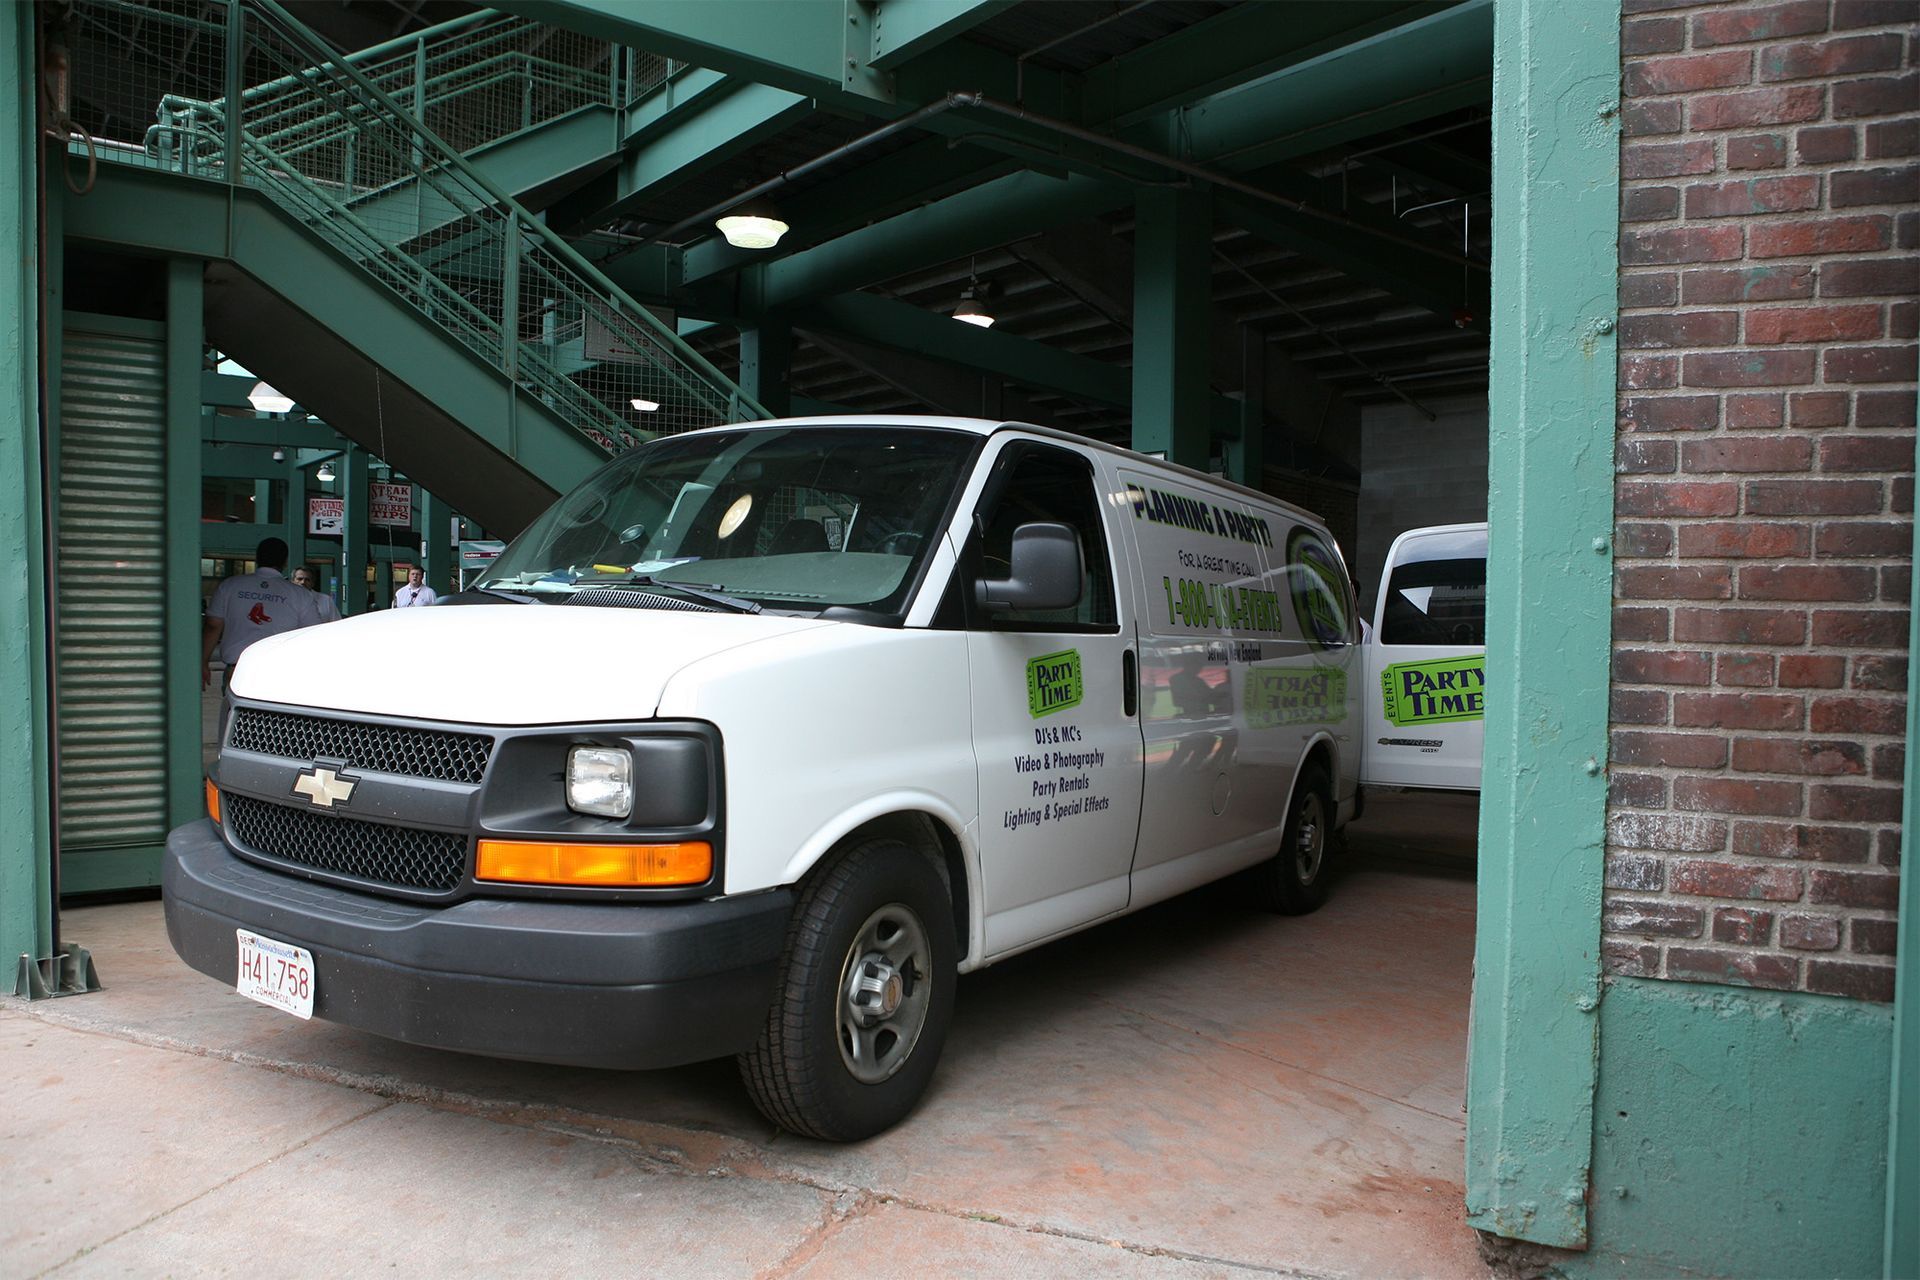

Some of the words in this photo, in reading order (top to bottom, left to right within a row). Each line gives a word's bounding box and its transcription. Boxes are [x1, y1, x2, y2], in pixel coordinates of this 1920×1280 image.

[371, 484, 409, 499] STEAK
[371, 503, 409, 512] TURKEY
[371, 510, 409, 520] TIPS
[1126, 482, 1215, 535] PLANNING
[1212, 505, 1229, 538] A
[1222, 508, 1274, 549] PARTY?
[1178, 550, 1196, 568] FOR
[1196, 554, 1204, 571] A
[1203, 555, 1224, 573] GREAT
[1224, 559, 1241, 576] TIME
[238, 591, 288, 603] SECURITY
[1162, 576, 1282, 633] 1-800-USA-EVENTS
[1036, 662, 1073, 690] PARTY
[1401, 667, 1485, 699] PARTY
[1038, 683, 1073, 707] TIME
[1384, 672, 1398, 718] EVENTS
[1404, 690, 1484, 717] TIME
[1035, 727, 1053, 745] DJ's
[1052, 727, 1060, 743] &
[1061, 725, 1082, 742] MC's
[1014, 754, 1042, 773] Video
[1043, 753, 1051, 770] &
[1053, 747, 1105, 770] Photography
[1032, 780, 1057, 799] Party
[1059, 773, 1090, 793] Rentals
[1003, 807, 1042, 831] Lighting
[1044, 803, 1051, 821] &
[1053, 797, 1083, 822] Special
[1084, 795, 1110, 813] Effects
[255, 986, 293, 1007] COMMERCIAL
